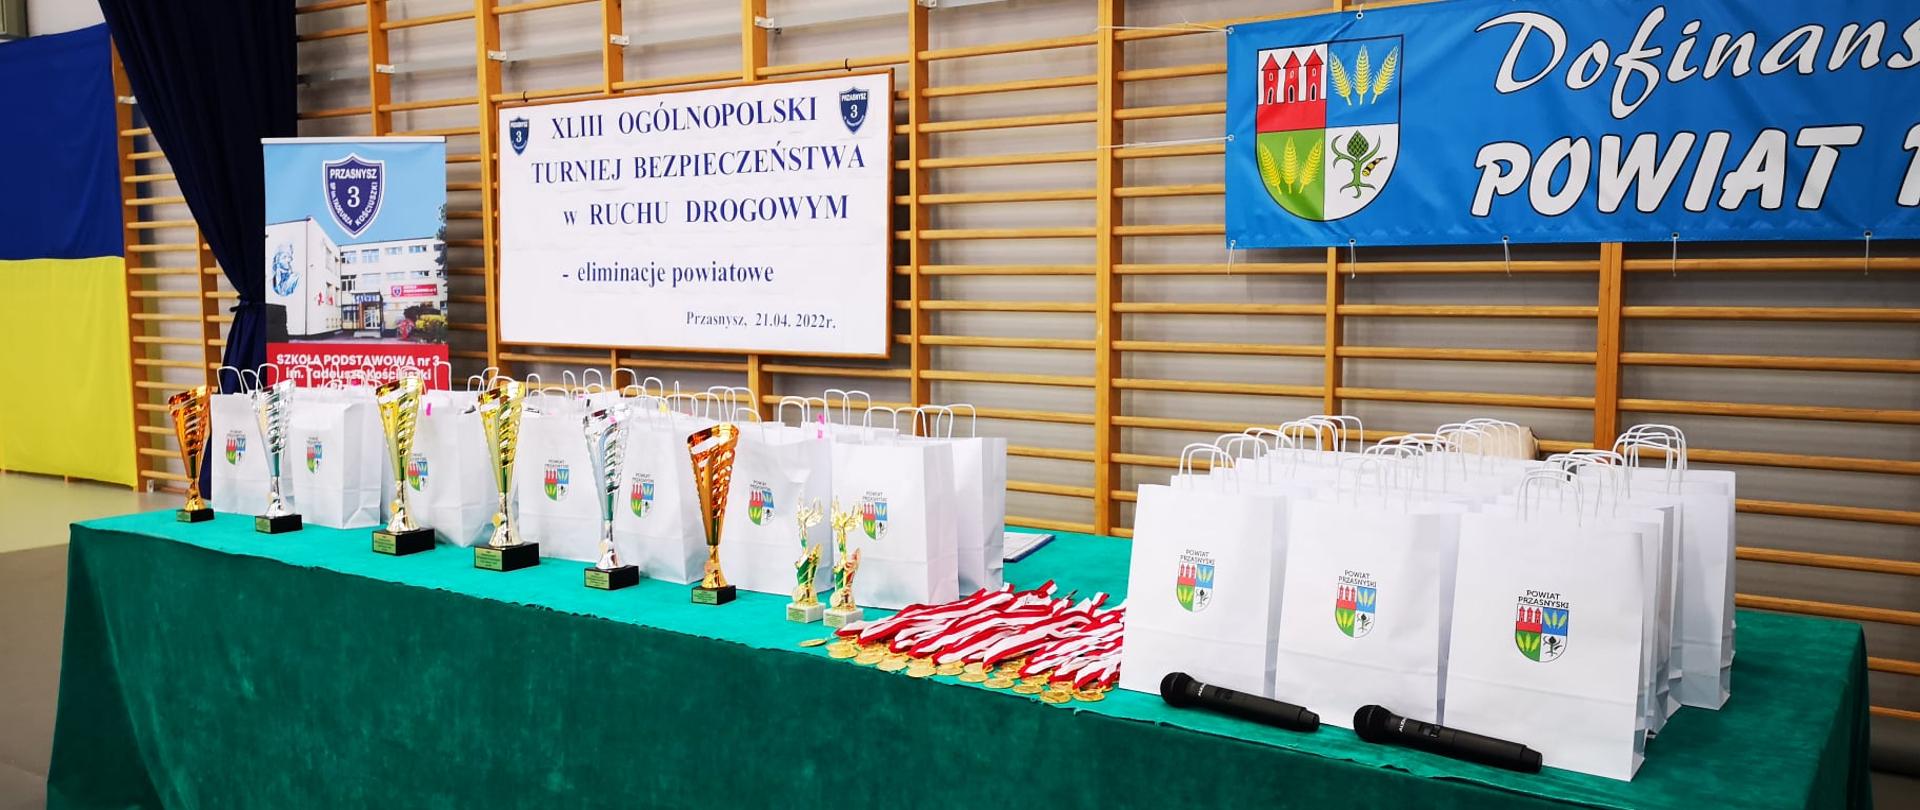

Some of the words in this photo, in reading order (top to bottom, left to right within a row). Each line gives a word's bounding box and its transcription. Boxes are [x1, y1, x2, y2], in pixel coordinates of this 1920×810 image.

[552, 114, 604, 139] XLIII
[618, 97, 817, 134] OGÓLNOPOLSKI
[850, 104, 858, 119] 3
[516, 130, 522, 143] 3
[531, 158, 622, 184] TURNIEJ
[634, 141, 865, 179] BEZPIECZEŃSTWA
[329, 168, 377, 180] PRZASNYSZ
[1471, 125, 1864, 217] POWIAT
[347, 185, 360, 208] 3
[563, 210, 577, 226] w
[590, 201, 669, 225] RUCHU
[686, 194, 848, 223] DROGOWYM
[577, 261, 665, 288] eliminacje
[672, 261, 774, 288] powiatowe
[686, 311, 747, 329] Przasnysz,
[755, 312, 791, 328] 21.04.
[795, 313, 836, 329] 2022r.
[276, 354, 321, 366] SZKOŁA
[324, 354, 415, 367] PODSTAWOWA
[417, 357, 431, 367] nr
[432, 355, 440, 367] 3
[1344, 570, 1371, 579] POWIAT
[1518, 596, 1569, 608] PRZASNYSKI
[1526, 590, 1560, 600] POWIAT
